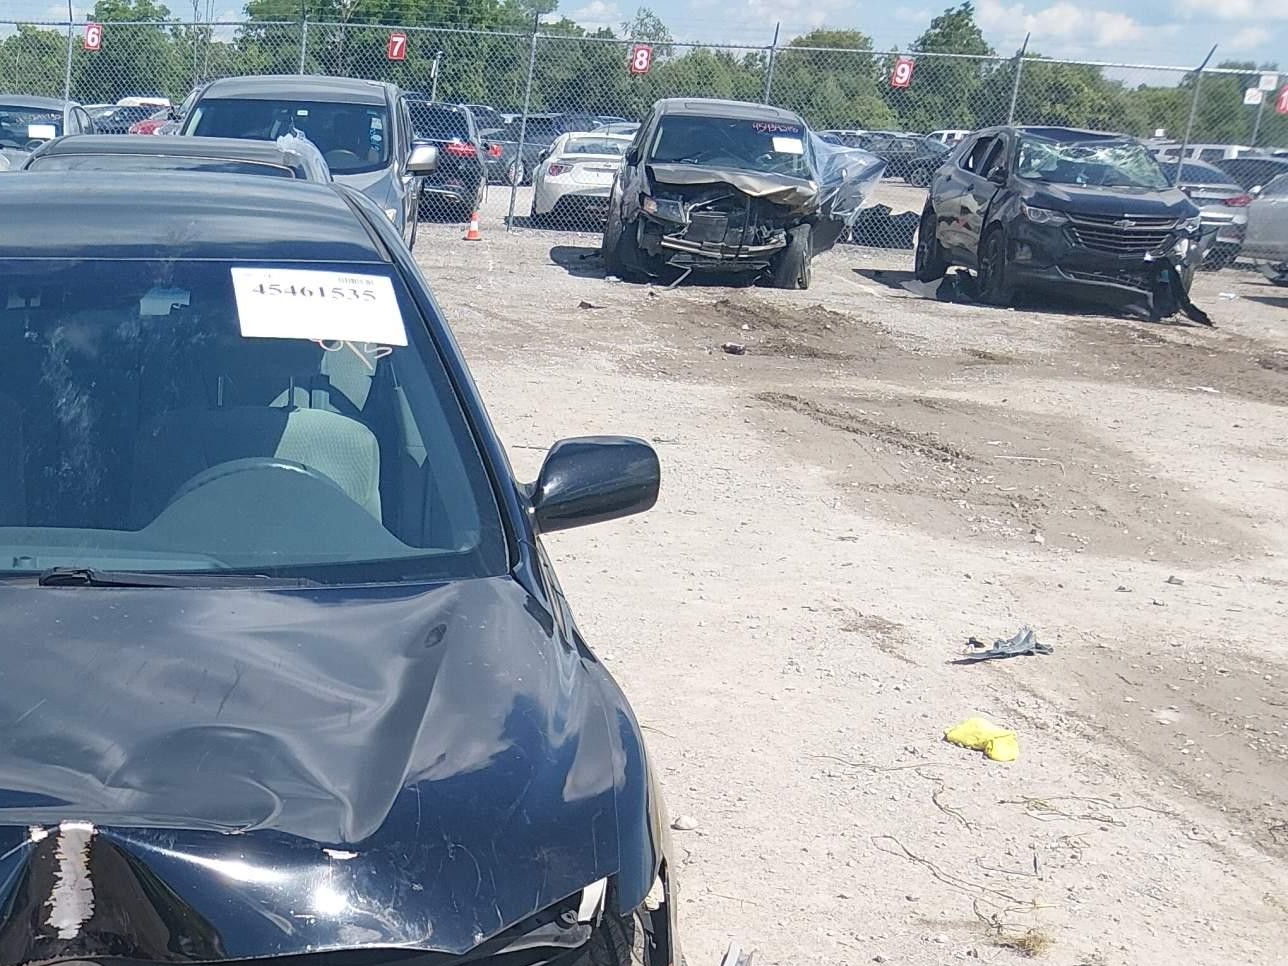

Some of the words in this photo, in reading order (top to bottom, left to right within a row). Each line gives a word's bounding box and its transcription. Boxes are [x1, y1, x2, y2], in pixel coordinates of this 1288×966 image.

[87, 27, 99, 47] 6
[392, 36, 405, 56] 7
[634, 49, 648, 70] 8
[895, 63, 910, 84] 9
[252, 283, 377, 302] 45461535
